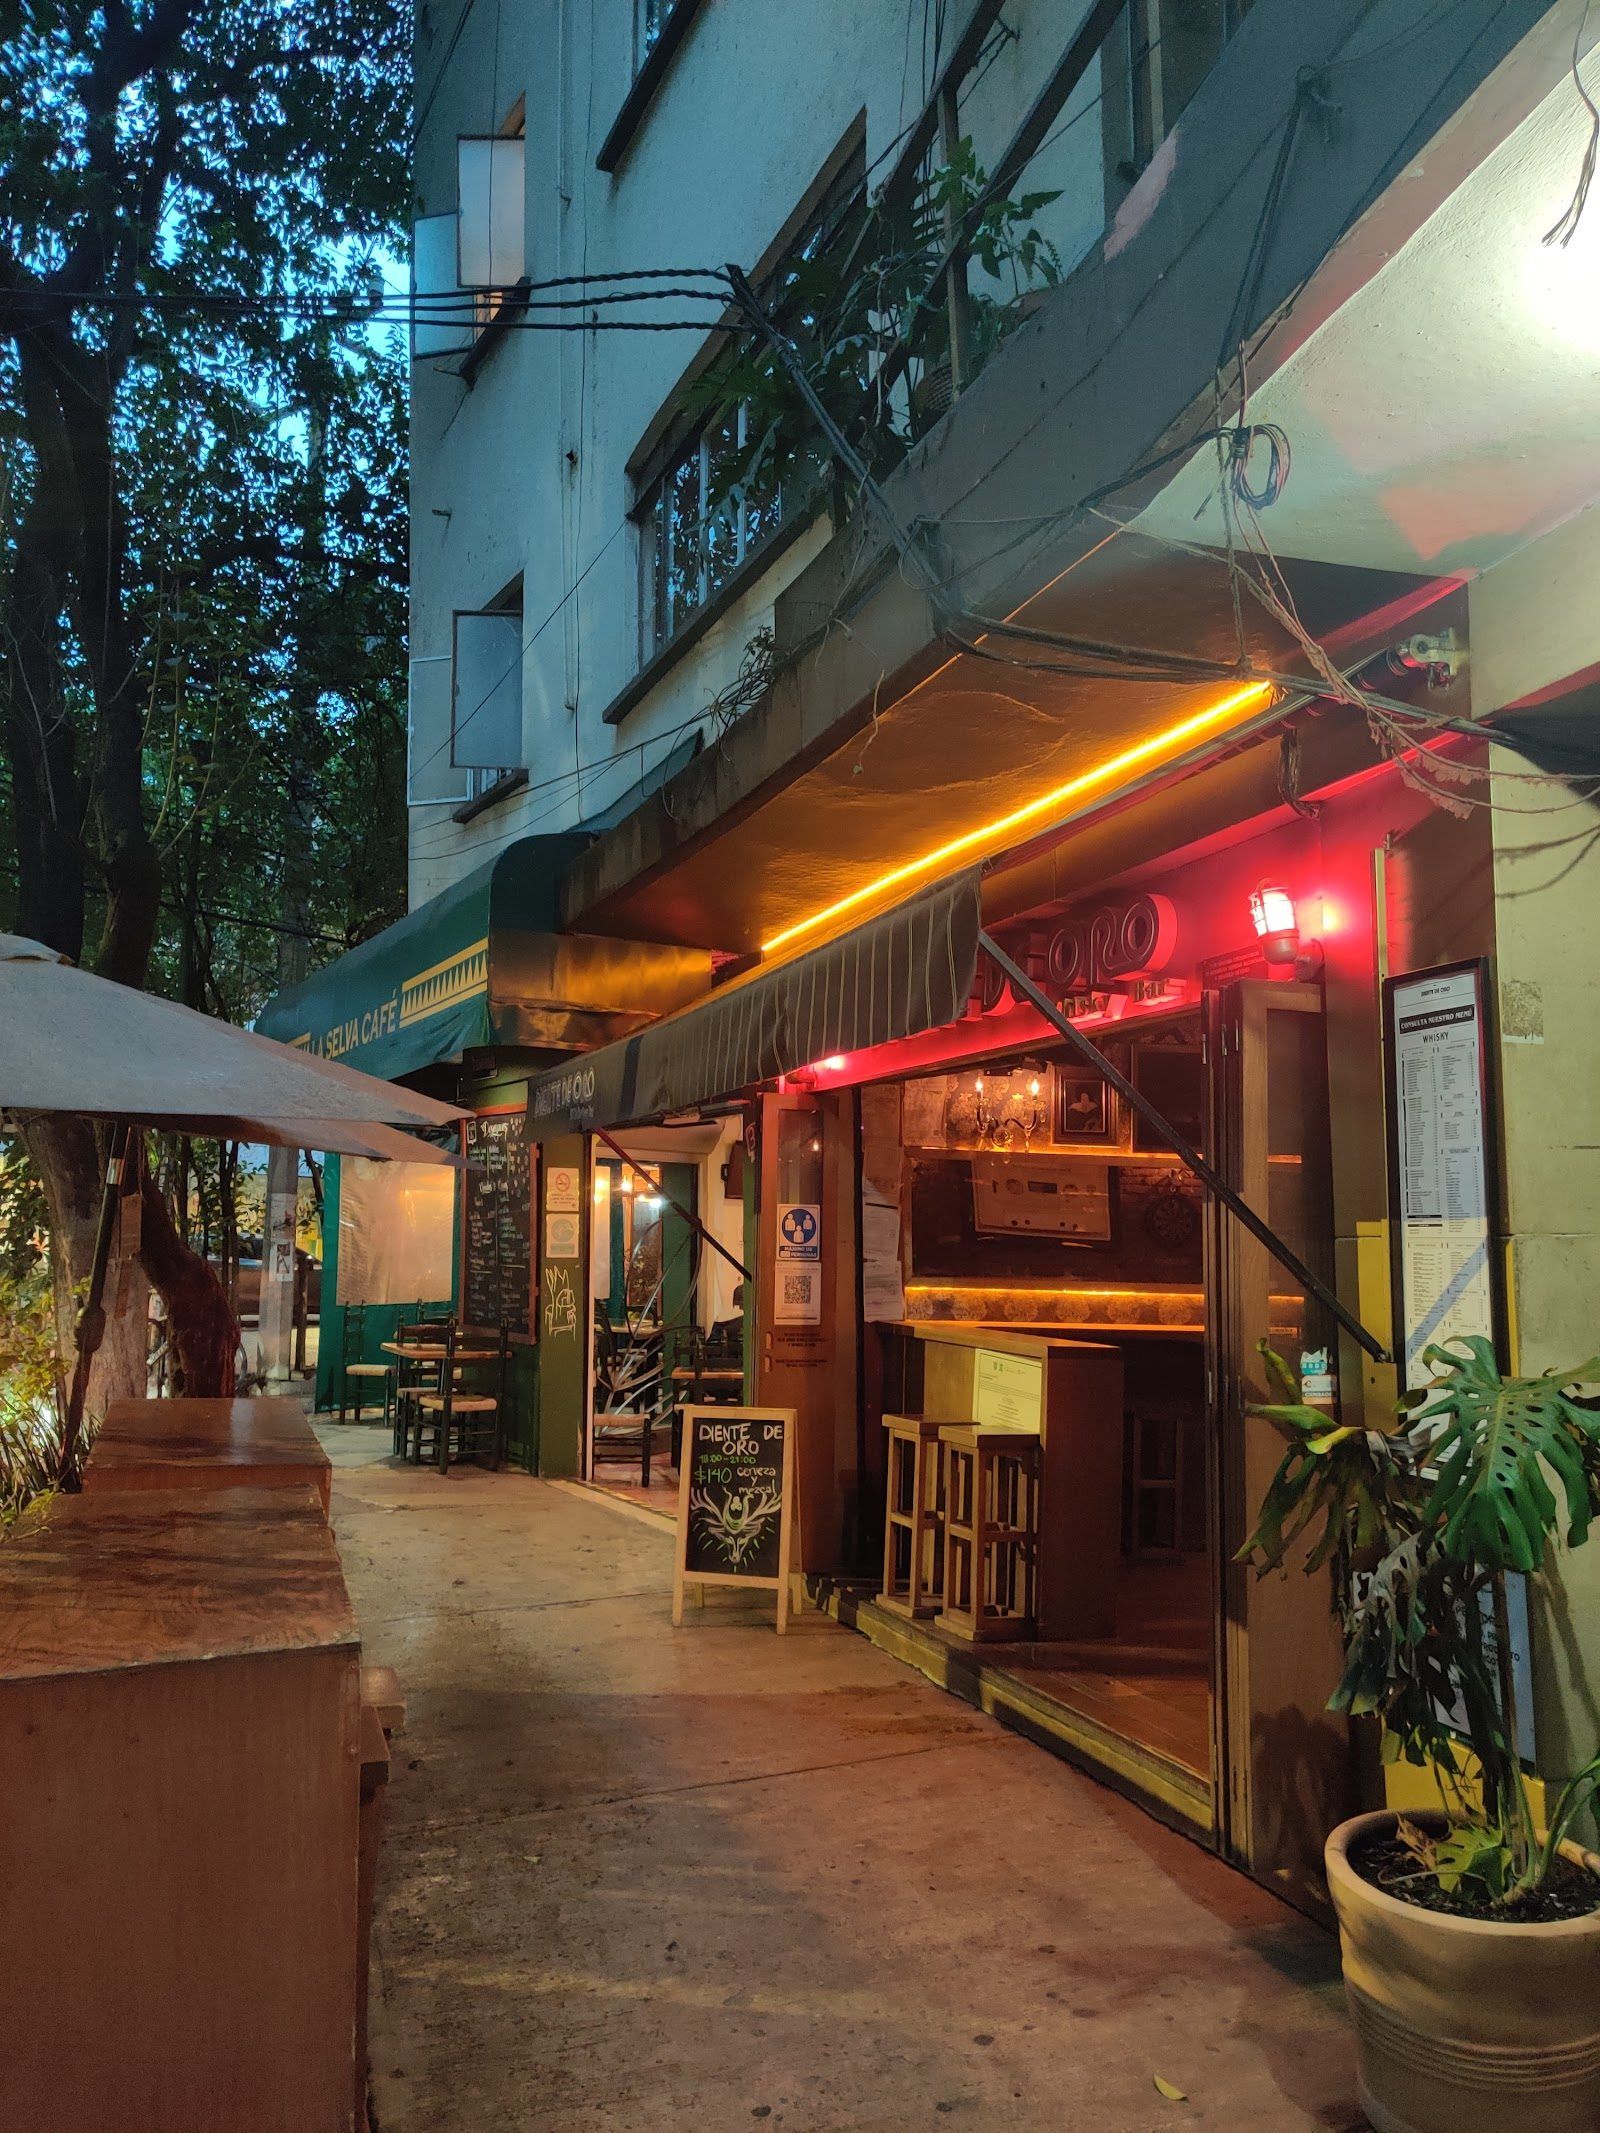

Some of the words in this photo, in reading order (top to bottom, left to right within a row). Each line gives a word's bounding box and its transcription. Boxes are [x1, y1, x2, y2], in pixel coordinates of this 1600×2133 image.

[326, 1018, 359, 1060] SELVA
[361, 988, 398, 1045] CAFÉ
[1400, 1017, 1427, 1030] CONSULTA
[1428, 1013, 1454, 1024] NUESTRO
[1455, 1007, 1473, 1019] MENÚ
[1422, 1031, 1449, 1044] WHISKY
[699, 1422, 752, 1443] DIENTE
[763, 1424, 784, 1441] DE
[721, 1440, 760, 1456] ORO
[693, 1465, 733, 1485] $140
[738, 1478, 777, 1496] mezcal
